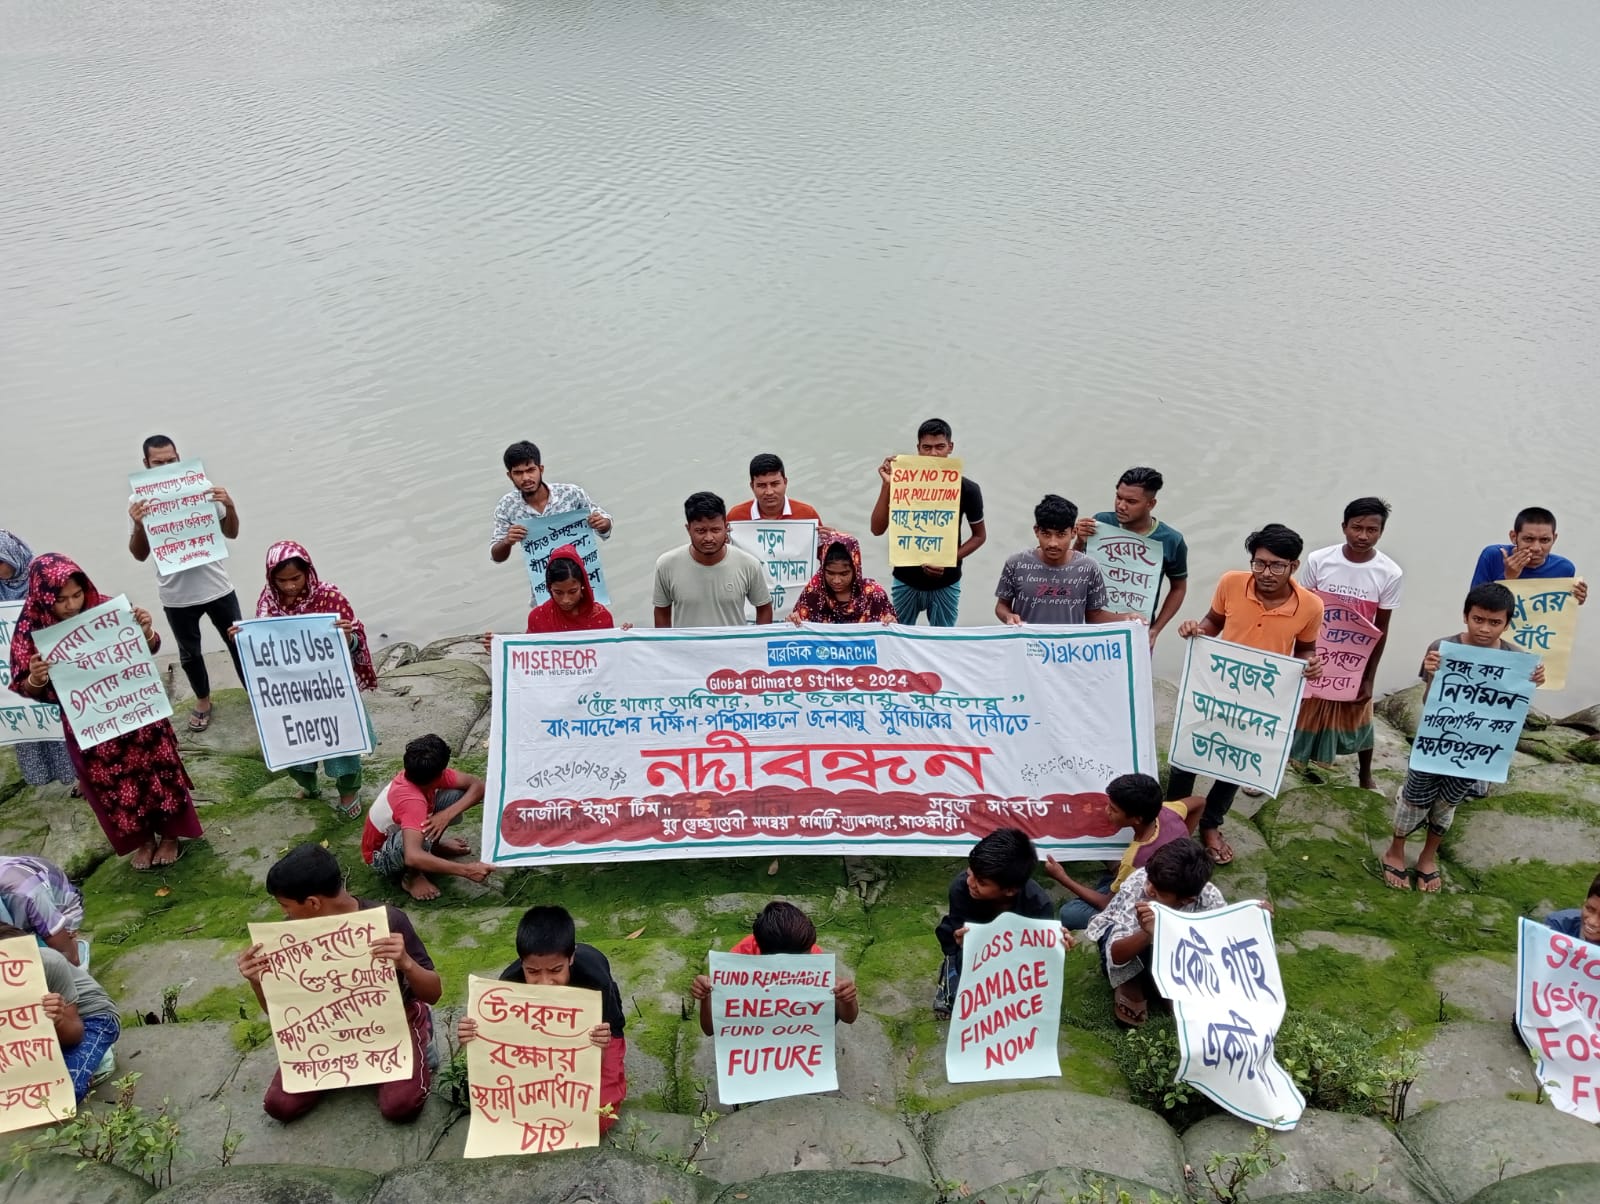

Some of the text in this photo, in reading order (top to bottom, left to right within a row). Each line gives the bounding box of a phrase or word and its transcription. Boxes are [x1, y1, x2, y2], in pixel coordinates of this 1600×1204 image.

[893, 469, 959, 482] SAY NO TO
[893, 488, 960, 506] AIR POLLUTION
[757, 529, 786, 558] নতুন
[897, 535, 944, 552] না বলো
[767, 560, 808, 581] আগমন
[1529, 591, 1572, 613] নয়
[47, 625, 95, 664] আমরা
[89, 609, 120, 631] নয়
[248, 629, 335, 667] Let us Use
[768, 642, 813, 662] বারসিক
[512, 649, 597, 672] MISEREOR
[831, 646, 875, 660] BARCIK
[1446, 658, 1511, 680] বন্ধ কর
[70, 663, 152, 719] আদায় করো
[257, 669, 346, 708] Renewable
[709, 677, 748, 690] Global
[751, 674, 803, 689] Climate
[808, 674, 854, 688] Strike
[869, 674, 909, 688] 2024
[1210, 654, 1281, 698] সবুজই
[1439, 672, 1529, 710] নির্গমন
[93, 681, 162, 714] আমাদের
[620, 697, 664, 712] থাকার
[669, 688, 750, 709] অধিকার,
[760, 690, 803, 708] চাই
[806, 692, 899, 710] জলবায়ু
[81, 717, 122, 742] পাওনা
[282, 714, 340, 747] Energy
[541, 717, 642, 739] বাংলাদেশের
[807, 710, 870, 734] জলবায়ু
[880, 704, 952, 735] সুবিচারের
[1192, 691, 1281, 741] আমাদের
[1424, 707, 1517, 734] পরিশোধন কর
[1192, 732, 1262, 777] ভবিষ্যৎ
[1416, 730, 1503, 769] ক্ষতিপূরণ
[517, 800, 574, 822] বনজীবি
[579, 800, 621, 826] ইয়ুথ
[628, 798, 661, 818] টিম
[928, 797, 976, 816] সবুজ
[986, 797, 1053, 819] সংহতি
[662, 818, 681, 835] যুব
[751, 815, 795, 830] সমন্বয়
[972, 928, 1057, 972] LOSS AND
[1170, 926, 1279, 1004] একটি গাছ
[713, 970, 749, 987] FUND
[959, 961, 1049, 1021] DAMAGE
[326, 986, 391, 1022] মানসিক
[478, 987, 589, 1038] উপকূল
[724, 999, 825, 1018] ENERGY
[720, 1024, 820, 1037] FUND OUR
[961, 993, 1043, 1052] FINANCE
[7, 1037, 54, 1068] বাংলা
[478, 1036, 590, 1073] রক্ষায়
[727, 1045, 823, 1077] FUTURE
[985, 1027, 1039, 1069] NOW
[470, 1073, 594, 1123] স্থায়ী সমাধান
